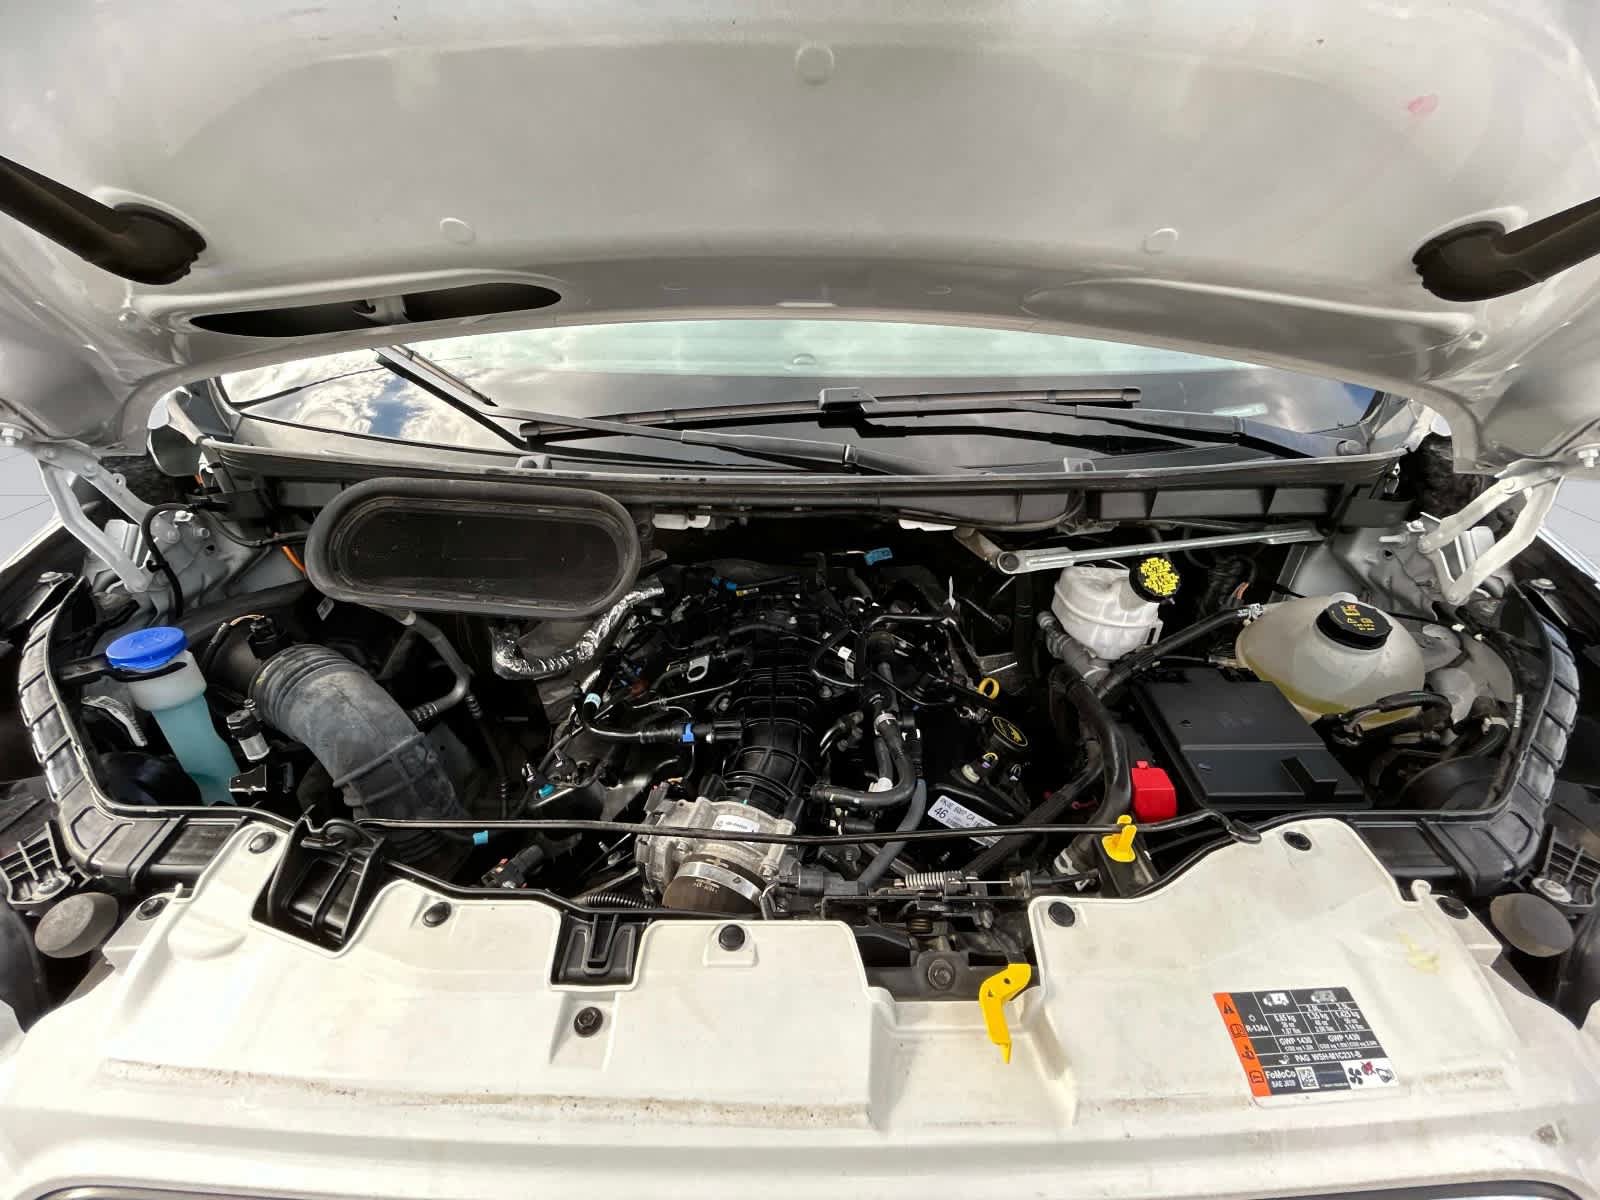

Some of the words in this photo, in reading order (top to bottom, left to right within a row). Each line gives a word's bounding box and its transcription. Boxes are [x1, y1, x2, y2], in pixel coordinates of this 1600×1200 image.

[934, 808, 949, 819] 46
[1246, 1024, 1269, 1032] R-134a
[1279, 1037, 1295, 1045] GWP
[1296, 1036, 1312, 1044] 1430
[1328, 1034, 1344, 1042] GWP
[1345, 1033, 1360, 1041] 1430
[1294, 1054, 1310, 1062] PAG
[1264, 1069, 1297, 1079] FoMoCo
[1271, 1080, 1283, 1088] SAE
